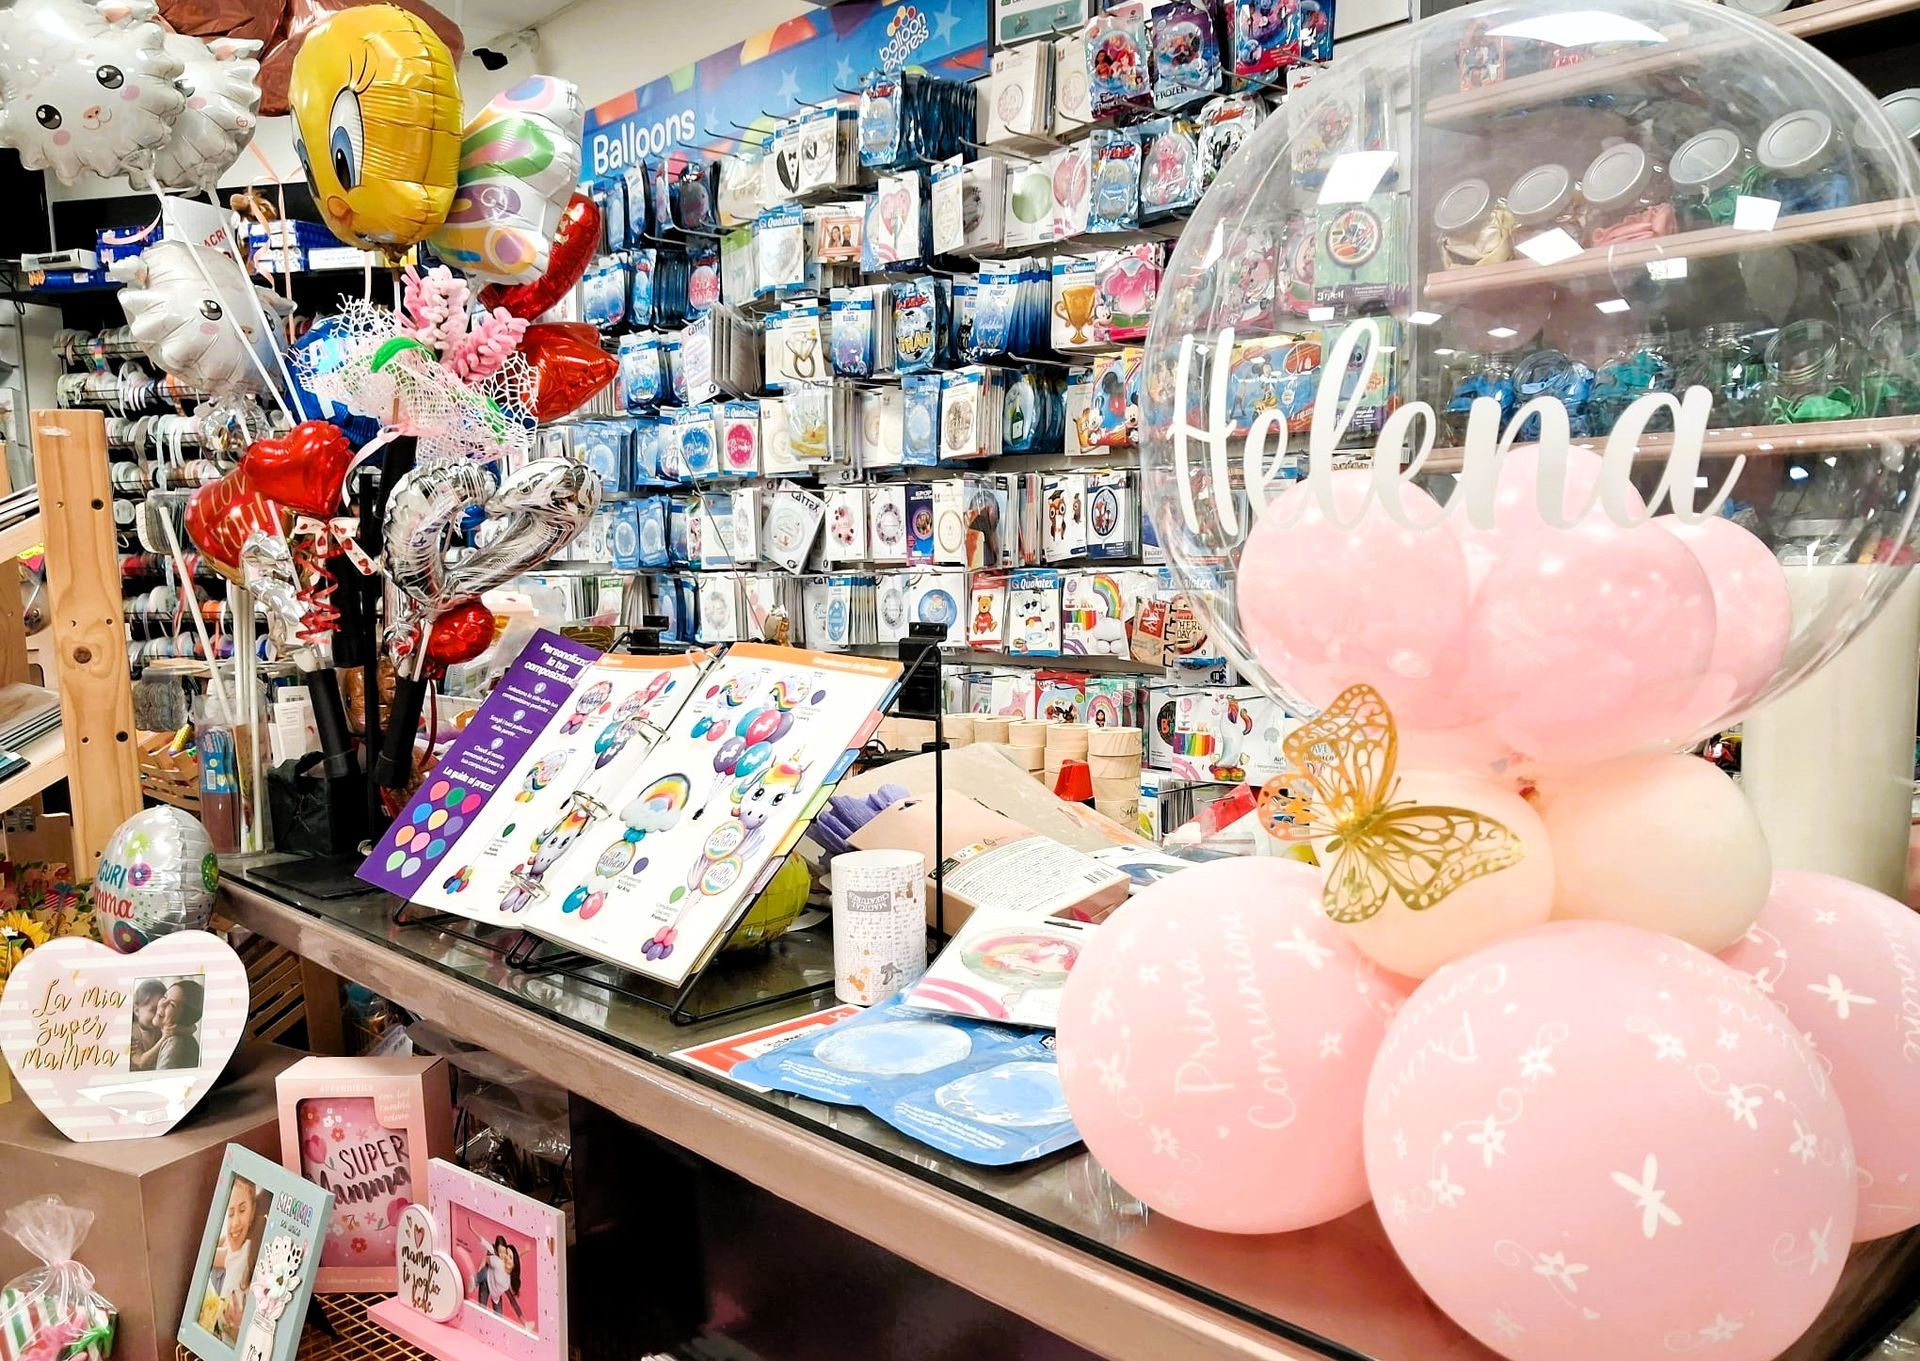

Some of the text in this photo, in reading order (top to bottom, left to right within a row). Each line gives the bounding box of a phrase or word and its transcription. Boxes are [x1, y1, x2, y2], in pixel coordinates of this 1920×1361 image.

[879, 12, 927, 62] balloon
[883, 26, 930, 74] express
[592, 107, 697, 175] Balloons
[767, 215, 800, 227] Qualatex
[1166, 316, 1748, 537] Helena
[206, 470, 250, 514] LOV
[556, 659, 570, 672] tua
[451, 771, 468, 783] guida
[474, 778, 496, 793] prezzi
[32, 978, 71, 1018] La
[1172, 945, 1236, 1096] Prima
[339, 1134, 411, 1181] SUPER
[276, 1191, 315, 1228] MAMMA
[401, 1245, 443, 1280] mamma
